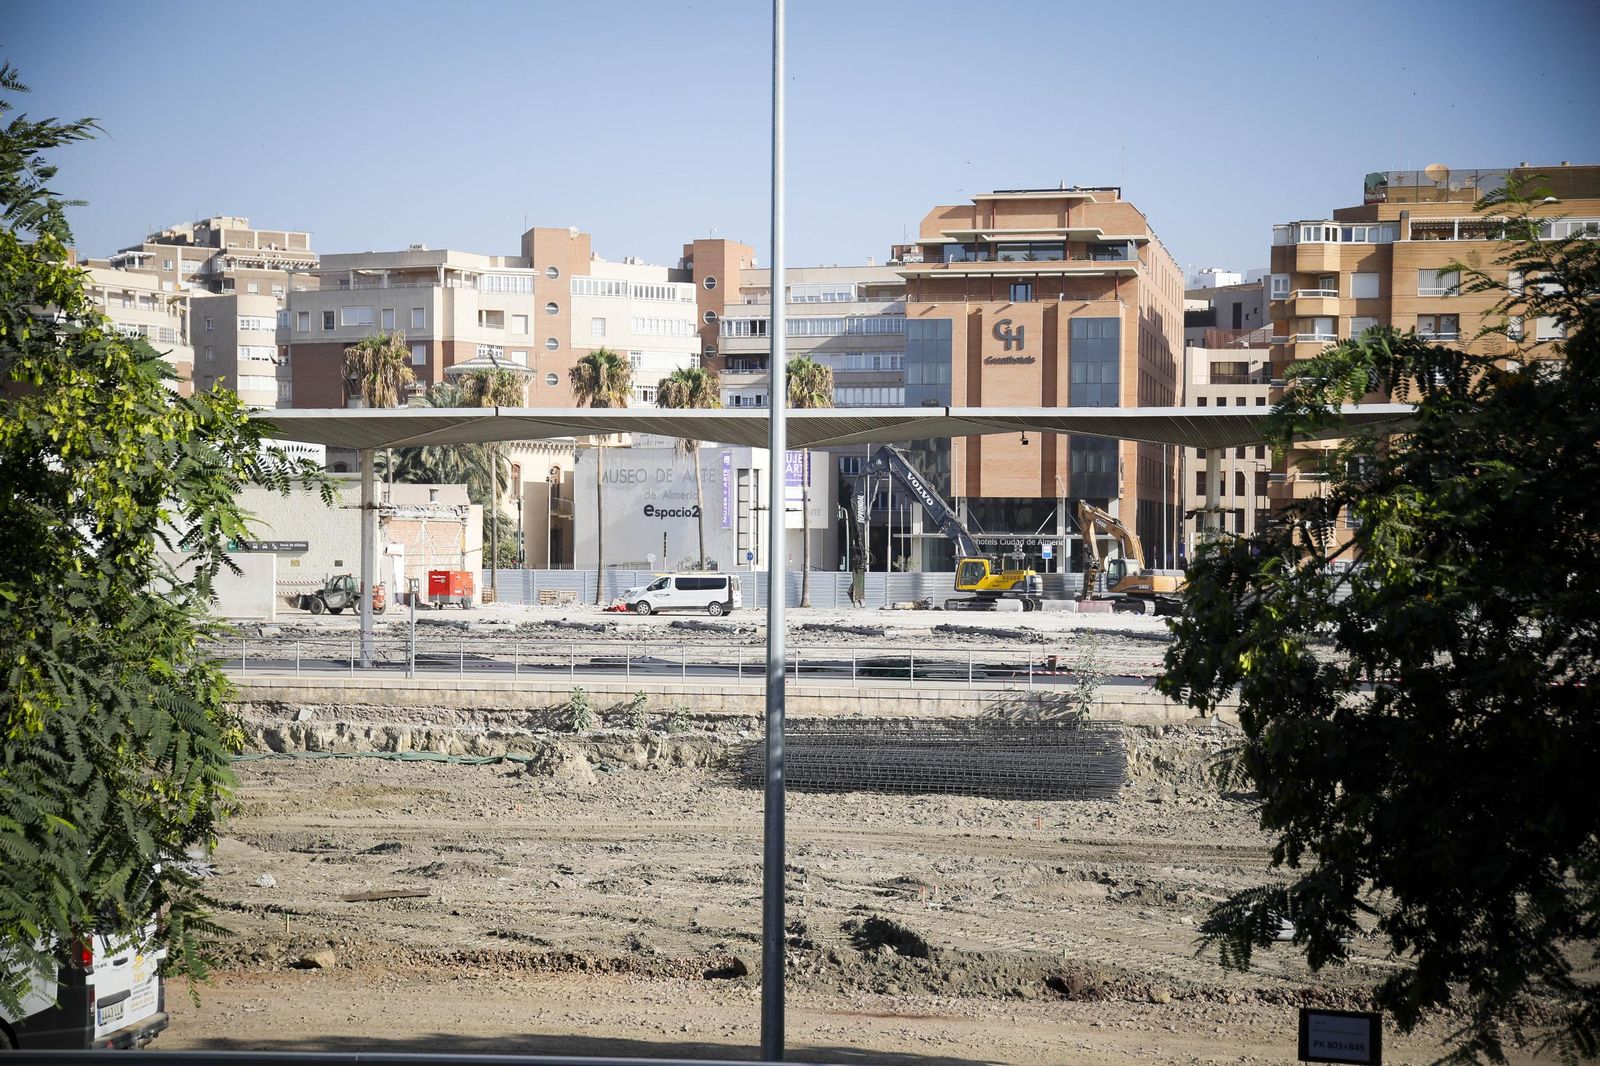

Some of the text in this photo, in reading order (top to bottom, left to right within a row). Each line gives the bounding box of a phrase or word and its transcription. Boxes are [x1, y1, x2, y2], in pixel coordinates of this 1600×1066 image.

[656, 468, 673, 483] DE
[683, 468, 716, 483] ATE
[644, 488, 656, 500] de
[907, 471, 934, 506] VOLVO
[643, 504, 700, 520] espacio2
[1000, 538, 1025, 546] Ciudad
[1026, 538, 1036, 546] de
[1313, 1040, 1325, 1049] PK
